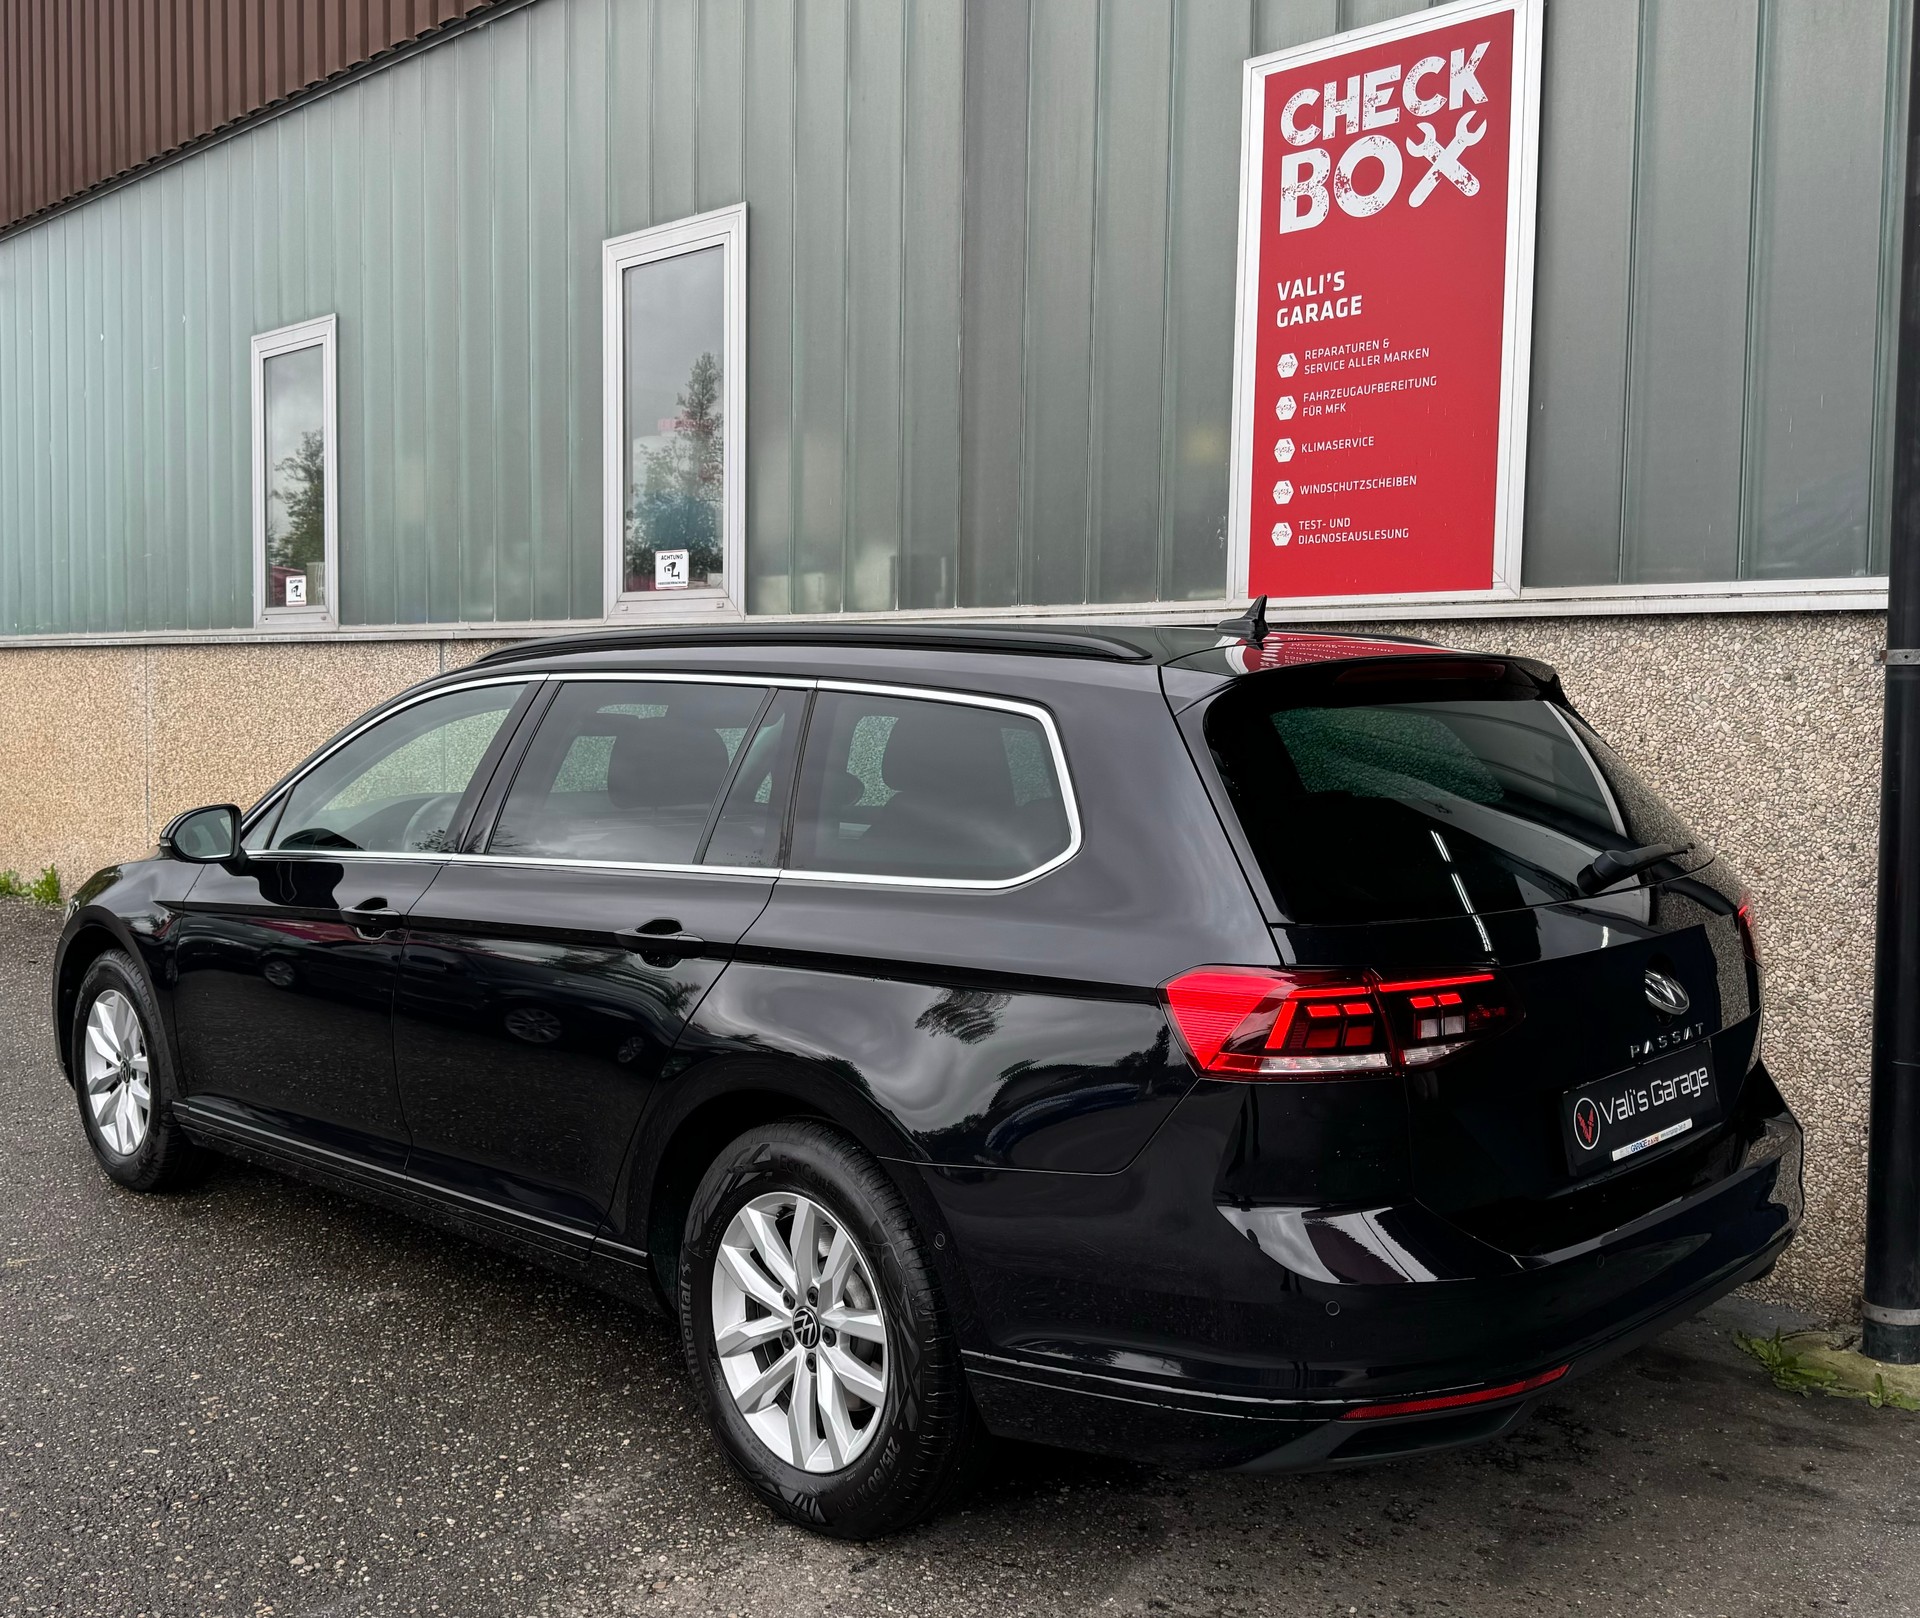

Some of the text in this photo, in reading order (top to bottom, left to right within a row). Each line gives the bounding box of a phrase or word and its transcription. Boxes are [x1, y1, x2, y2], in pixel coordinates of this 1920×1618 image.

[1280, 41, 1491, 146] CHECK
[1276, 295, 1363, 328] GARAGE
[1303, 347, 1430, 375] SERVICE ALLER MARKEN
[1304, 338, 1390, 360] REPARATUREN &
[1303, 375, 1437, 402] FAHRZEUGAUFBEREITUNG
[1302, 402, 1347, 417] FÜR MFK
[1301, 436, 1375, 453] KLIMASERVICE
[1299, 475, 1417, 495] WINDSCHUTZSCHEIBEN
[1298, 517, 1351, 530] TEST- UND
[1298, 527, 1409, 545] DIAGNOSEAUSLESUNG
[1630, 1022, 1704, 1058] PASSAT
[1599, 1066, 1709, 1125] Vali's Garage
